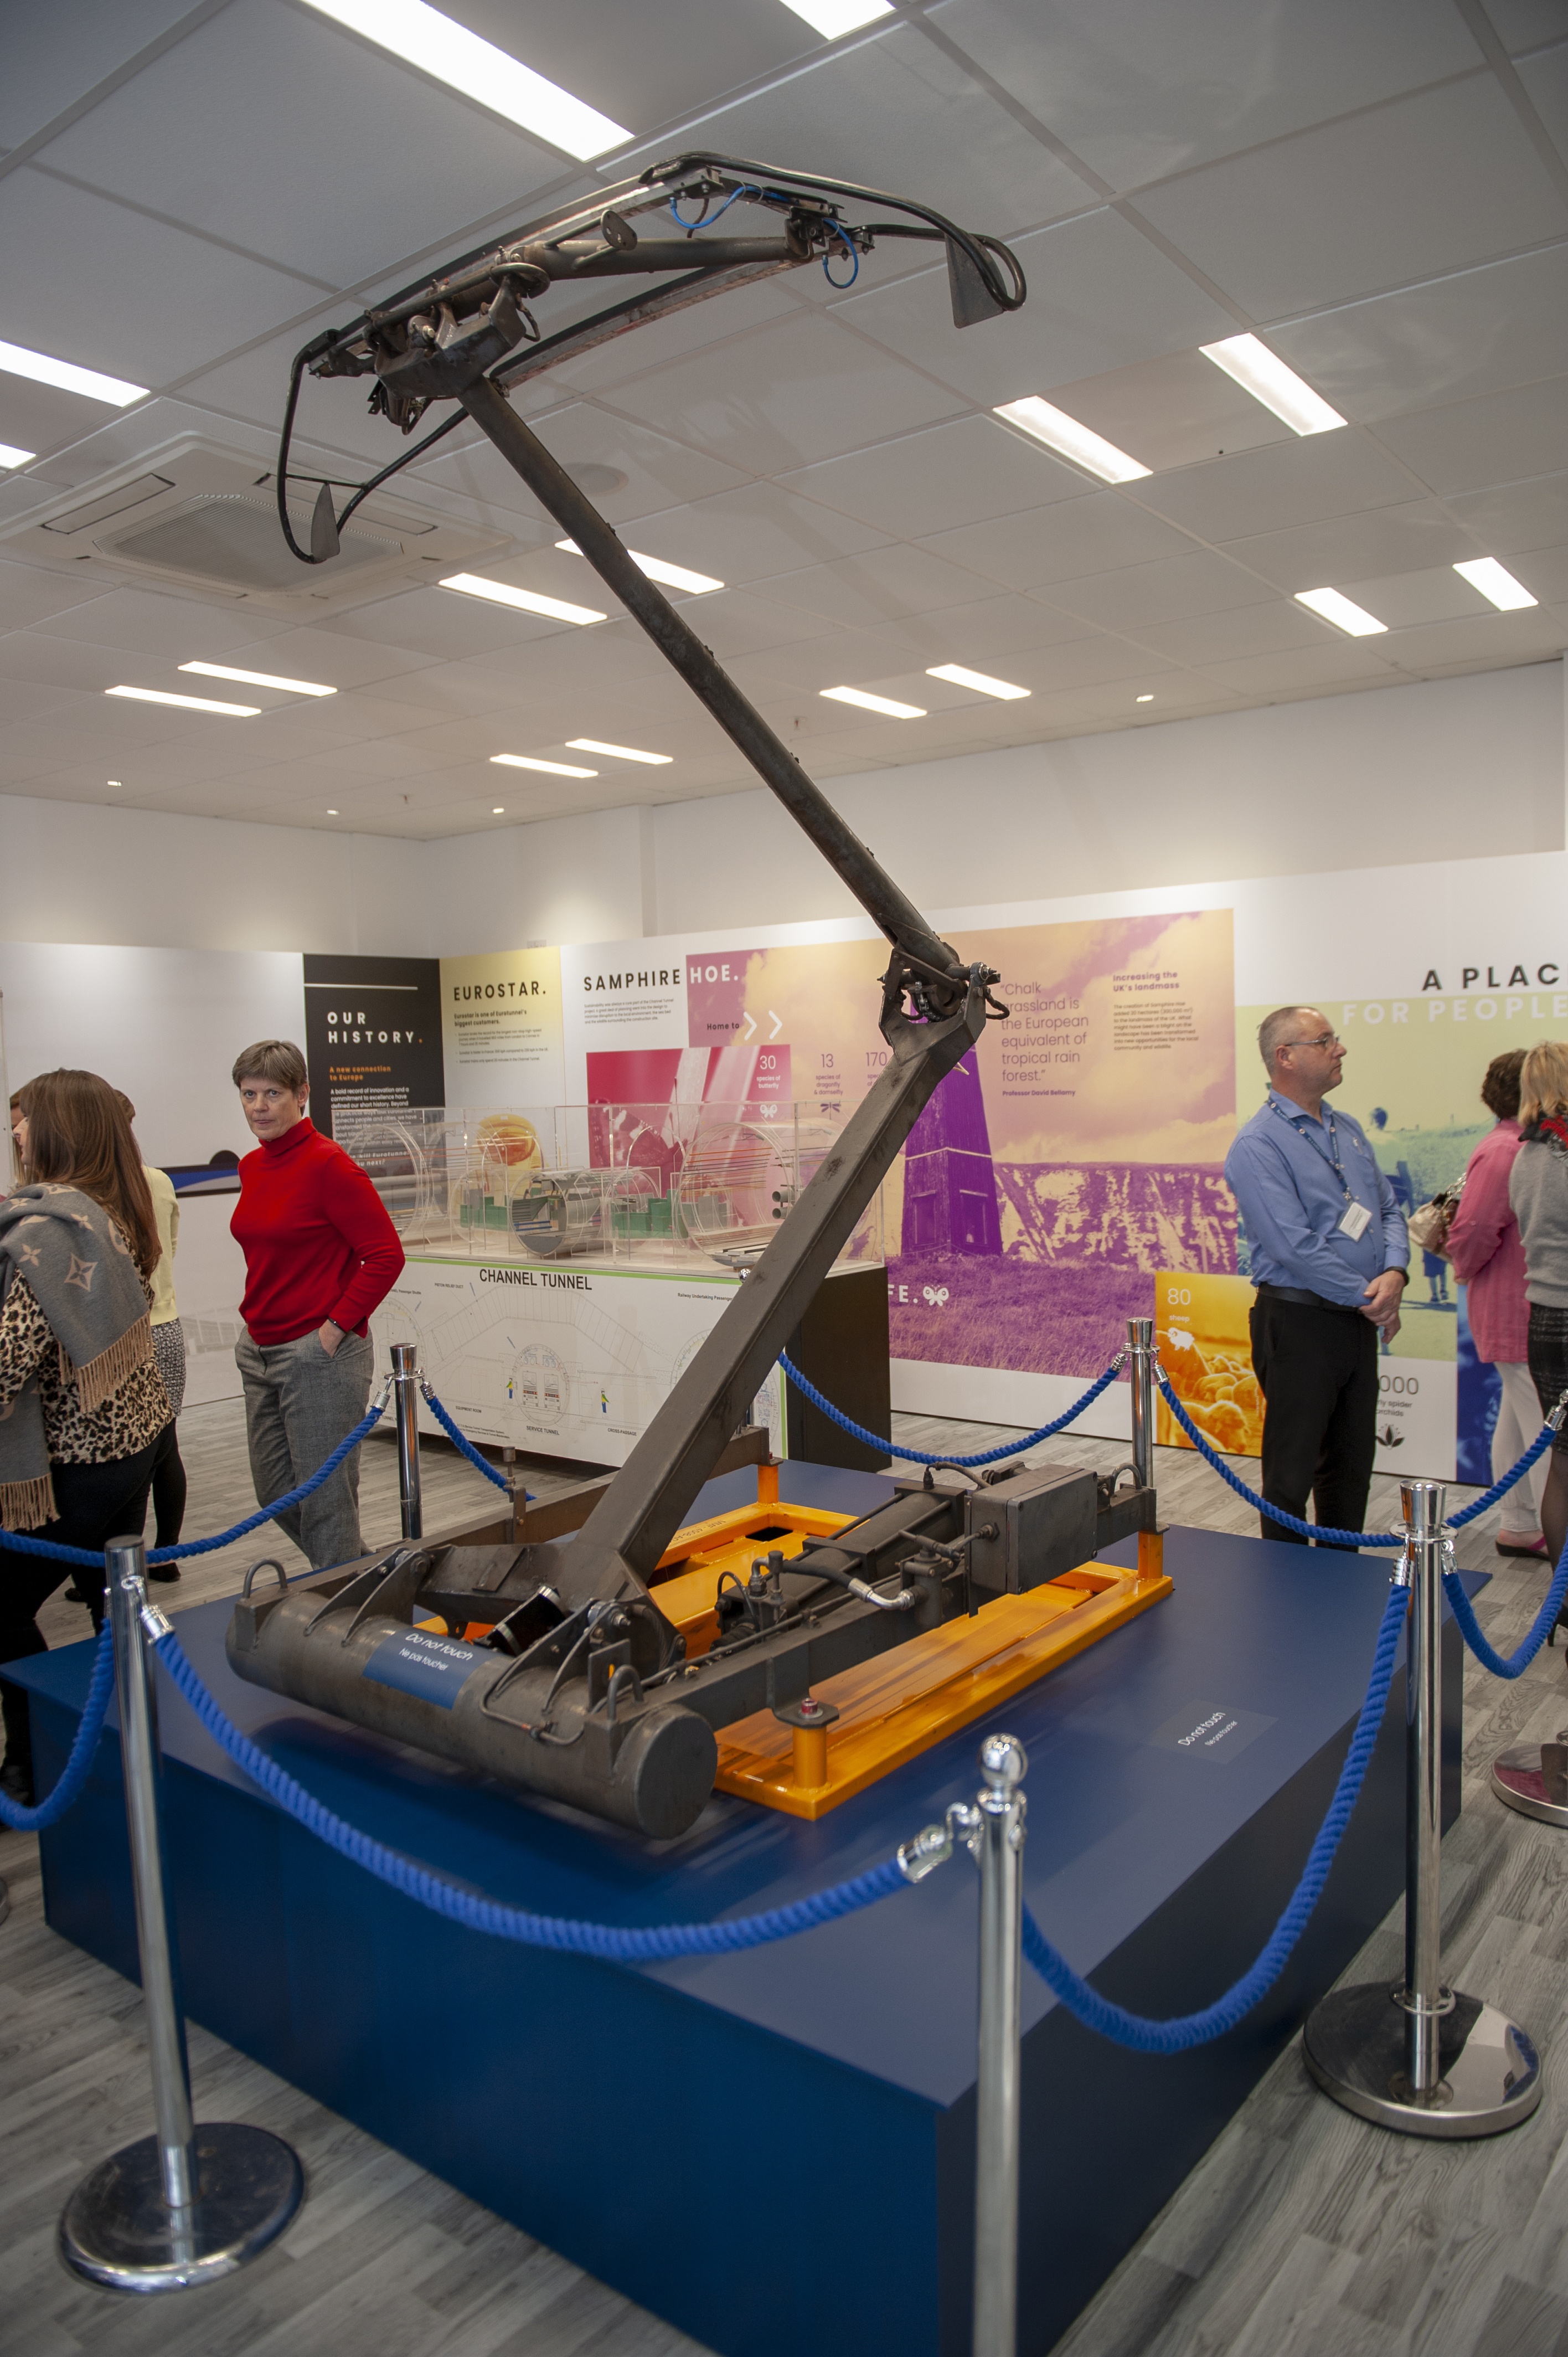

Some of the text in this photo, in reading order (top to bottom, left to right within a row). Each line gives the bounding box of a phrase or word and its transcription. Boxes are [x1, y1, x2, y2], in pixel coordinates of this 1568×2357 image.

[584, 964, 739, 991] SAMPHIRE HOE.
[1113, 970, 1178, 982] Increasing the
[1421, 963, 1568, 991] A PLAC
[454, 981, 545, 1001] EUROSTAR.
[1000, 981, 1041, 996] “Chalk
[1134, 982, 1179, 991] landmass
[1004, 997, 1080, 1012] rassland is
[1342, 995, 1568, 1026] FOR PEOPLE
[327, 1011, 366, 1025] OUR
[1001, 1017, 1089, 1032] the European
[706, 1022, 729, 1031] Home
[328, 1031, 423, 1044] HISTORY.
[1001, 1032, 1087, 1051] equivalent of
[759, 1054, 776, 1070] 30
[821, 1054, 834, 1068] 13
[865, 1052, 887, 1067] 170
[1002, 1051, 1080, 1068] tropical rain
[1002, 1069, 1046, 1082] forest.”
[816, 1081, 840, 1089] dragonfly
[372, 1101, 389, 1109] history.
[390, 1100, 409, 1109] Beyond
[479, 1269, 592, 1290] CHANNEL TUNNEL
[1168, 1288, 1191, 1306] 80
[1169, 1314, 1190, 1324] sheep
[1379, 1375, 1419, 1395] 000
[607, 1427, 637, 1436] CROSS-PASSAGE
[405, 1633, 473, 1661] Do not touch
[399, 1647, 449, 1671] Ne pas toucher
[1178, 1711, 1226, 1746] Do not touch
